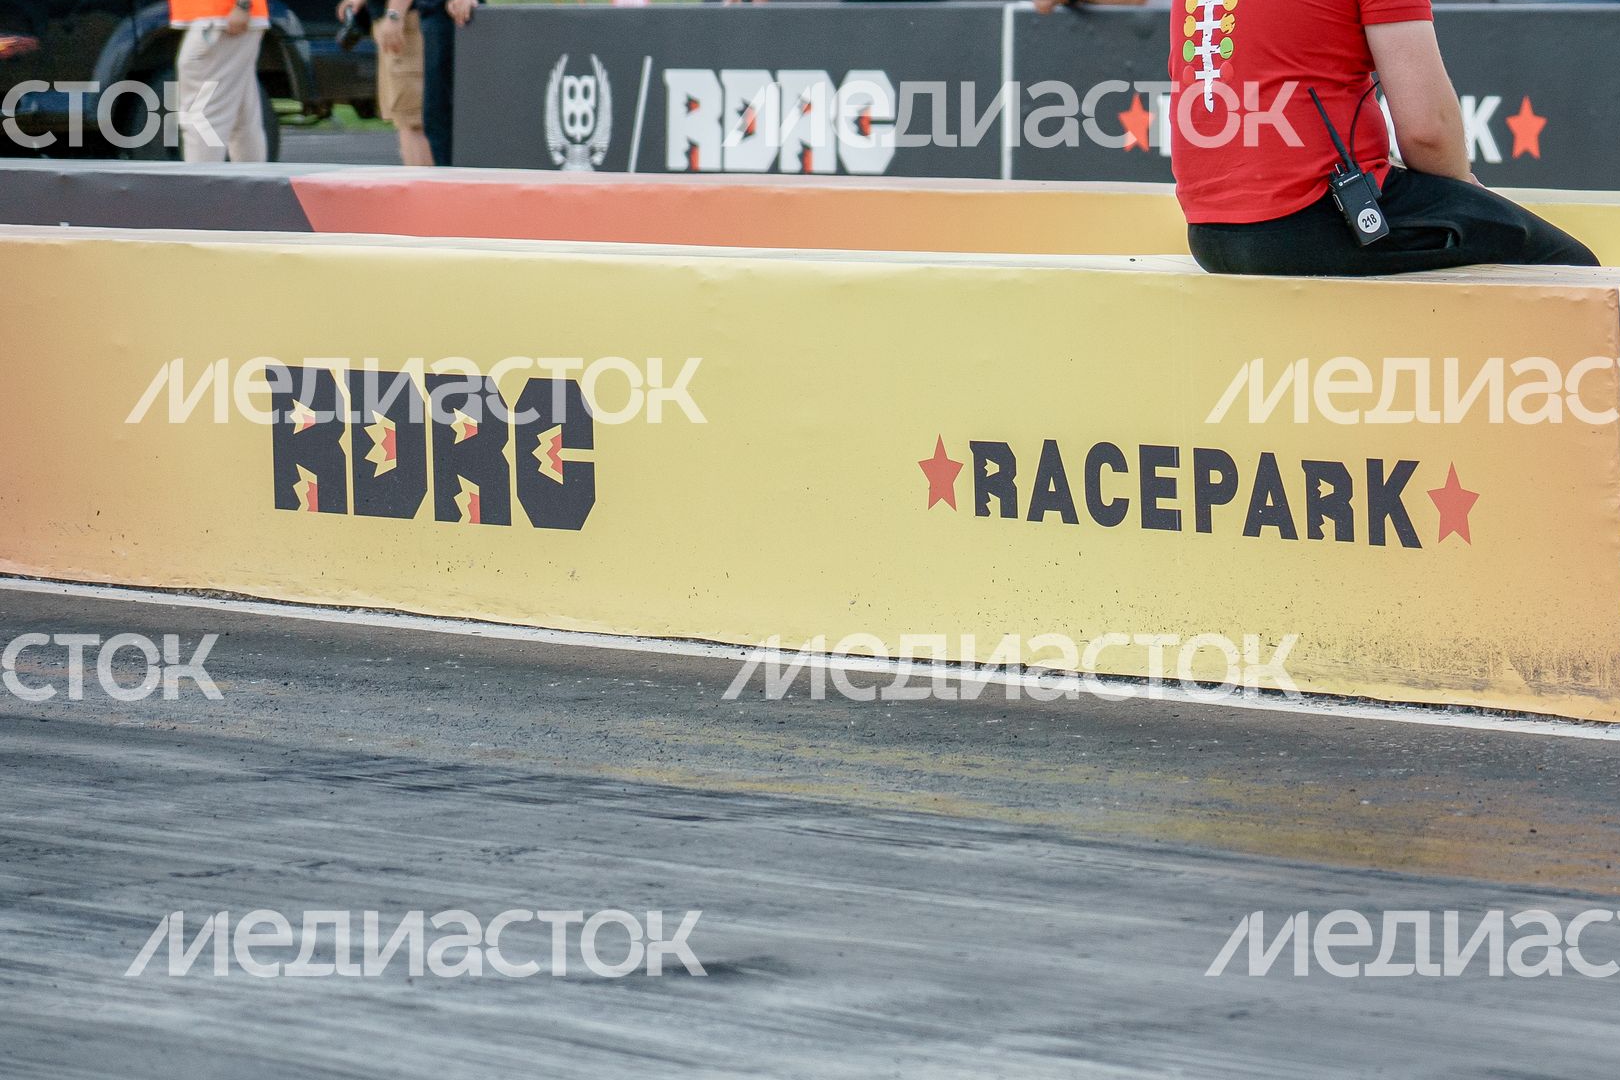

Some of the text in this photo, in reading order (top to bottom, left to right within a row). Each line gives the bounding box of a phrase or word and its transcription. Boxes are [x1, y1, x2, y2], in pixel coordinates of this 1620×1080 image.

[663, 68, 897, 175] RDRC
[1361, 213, 1378, 229] 218
[264, 364, 596, 531] RDRC
[968, 438, 1423, 549] RACEPARK
